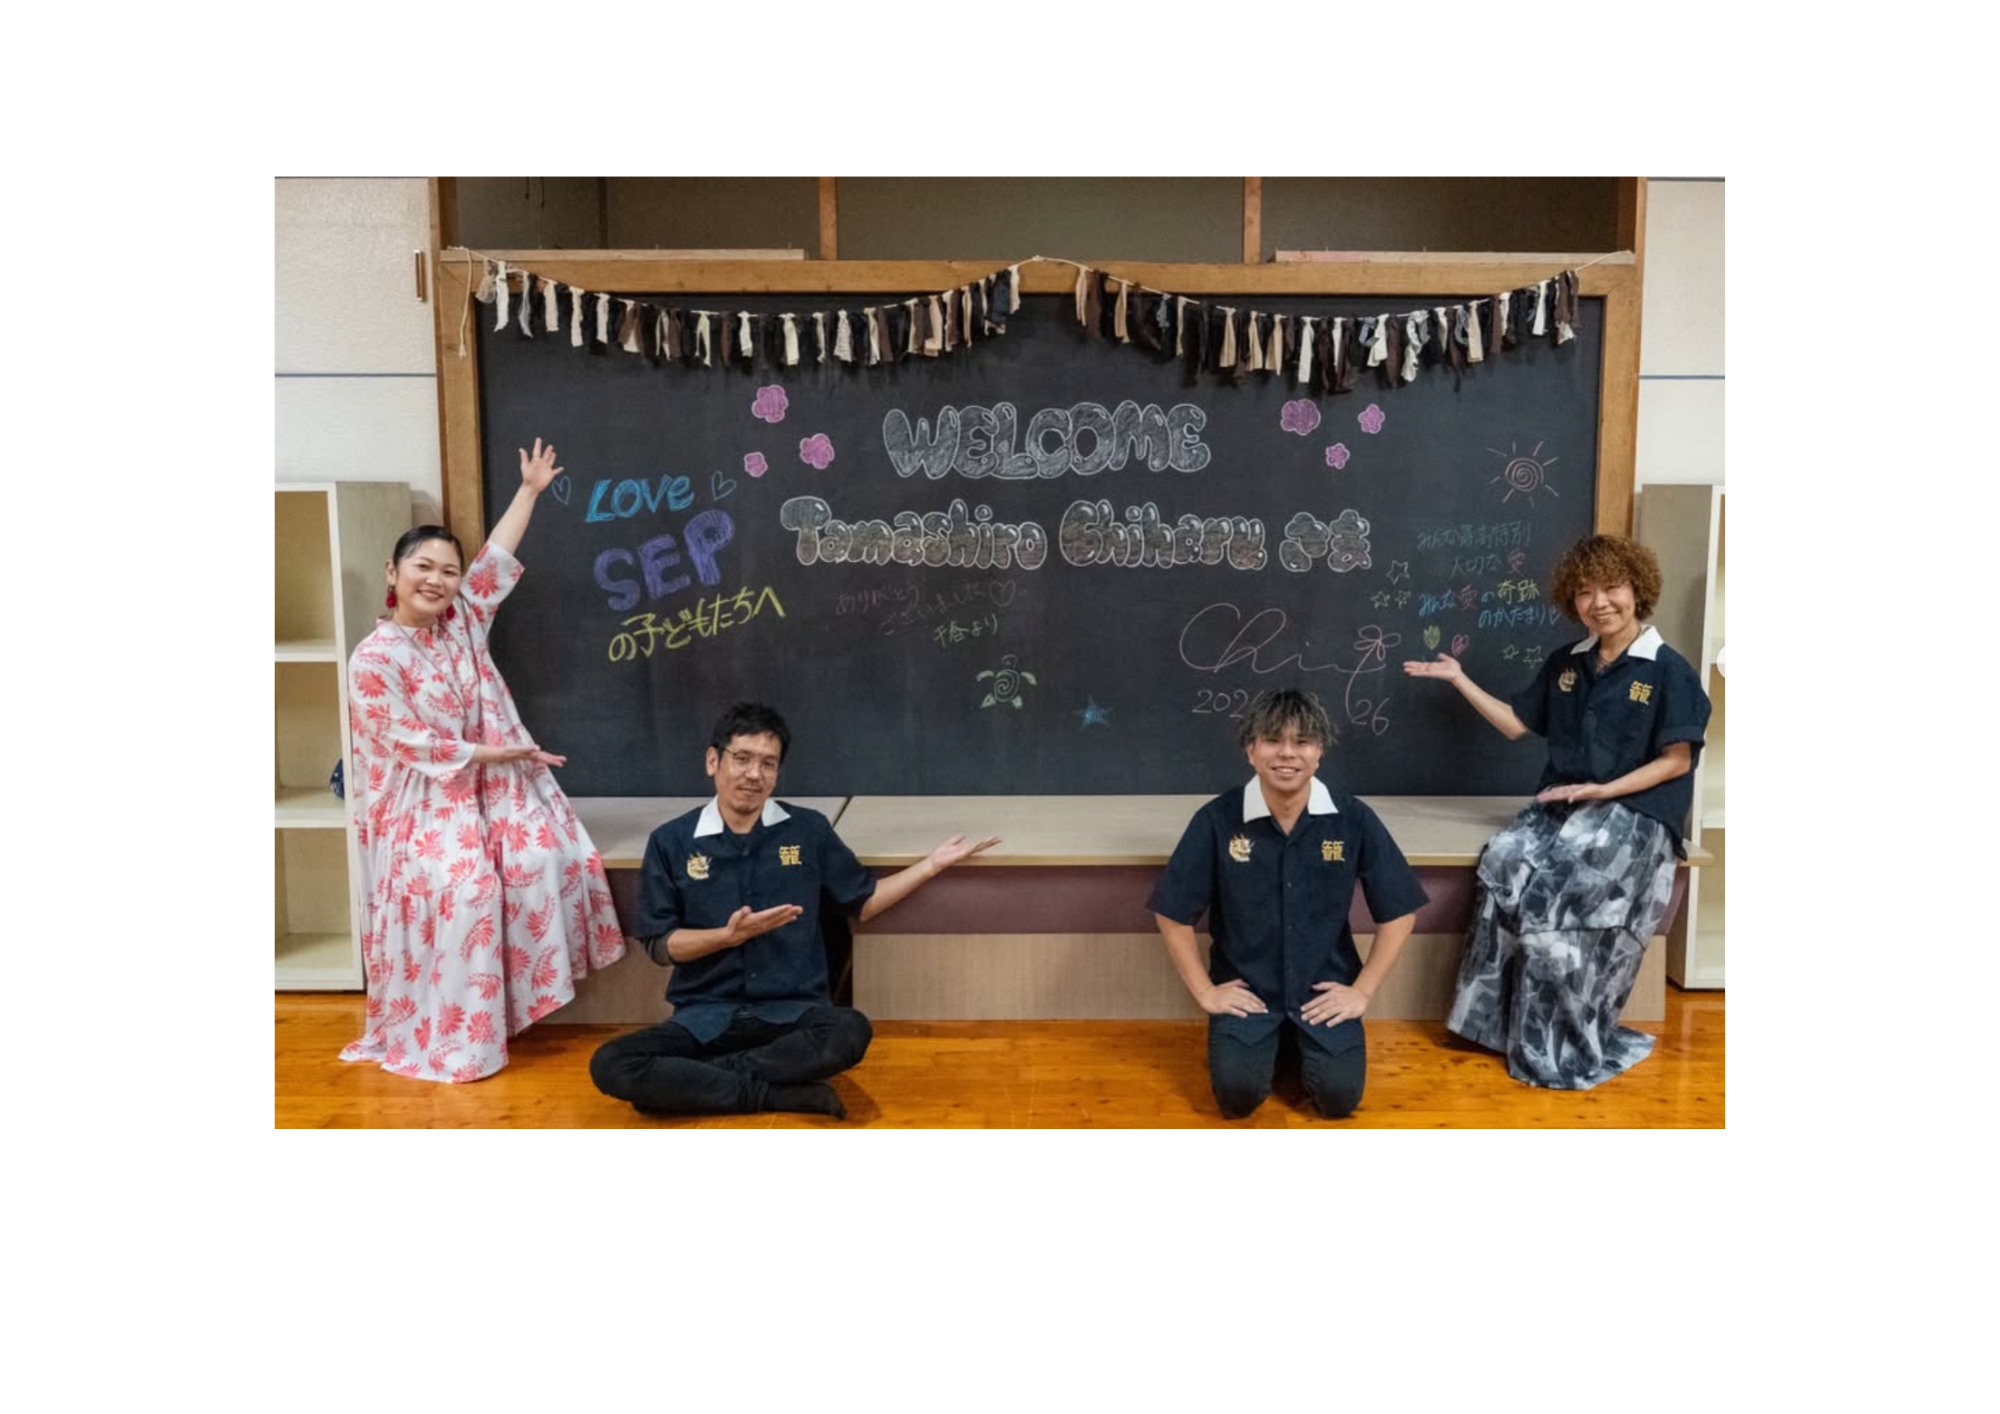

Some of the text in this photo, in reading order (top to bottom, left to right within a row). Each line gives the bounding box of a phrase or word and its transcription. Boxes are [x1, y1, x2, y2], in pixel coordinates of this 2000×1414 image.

[883, 400, 1210, 479] WELCOME
[593, 508, 735, 611] SEP
[780, 496, 1372, 572] Tamashiro Chiharu さま
[608, 586, 786, 662] の子どもたちへ
[836, 580, 920, 615] ありがとう
[880, 581, 987, 636] ございました
